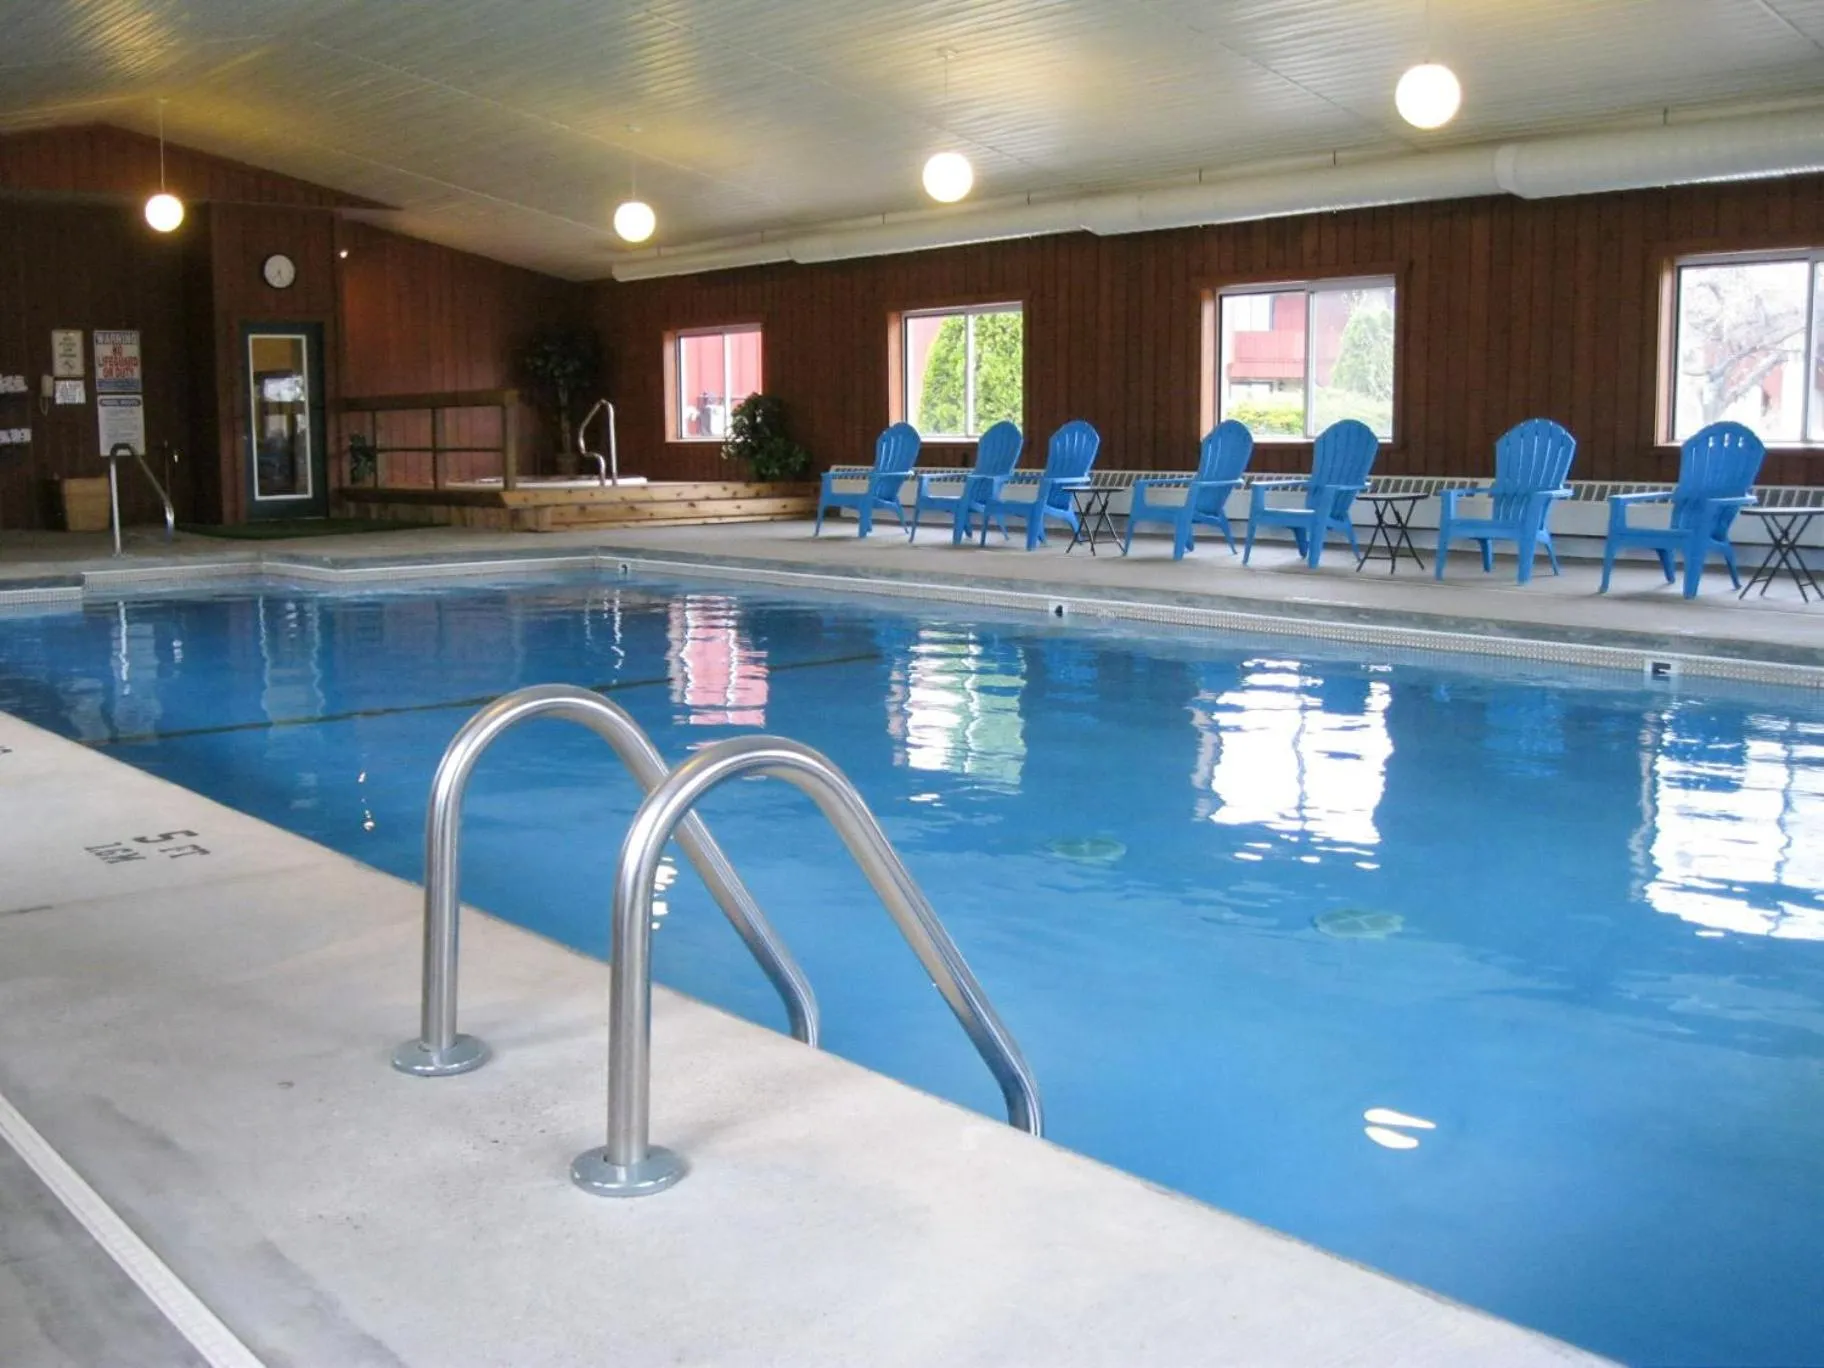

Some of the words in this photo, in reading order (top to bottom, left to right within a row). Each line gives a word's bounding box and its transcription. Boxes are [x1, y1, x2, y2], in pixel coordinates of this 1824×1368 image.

[112, 344, 123, 356] NO
[132, 829, 199, 844] 5
[159, 843, 211, 859] FT
